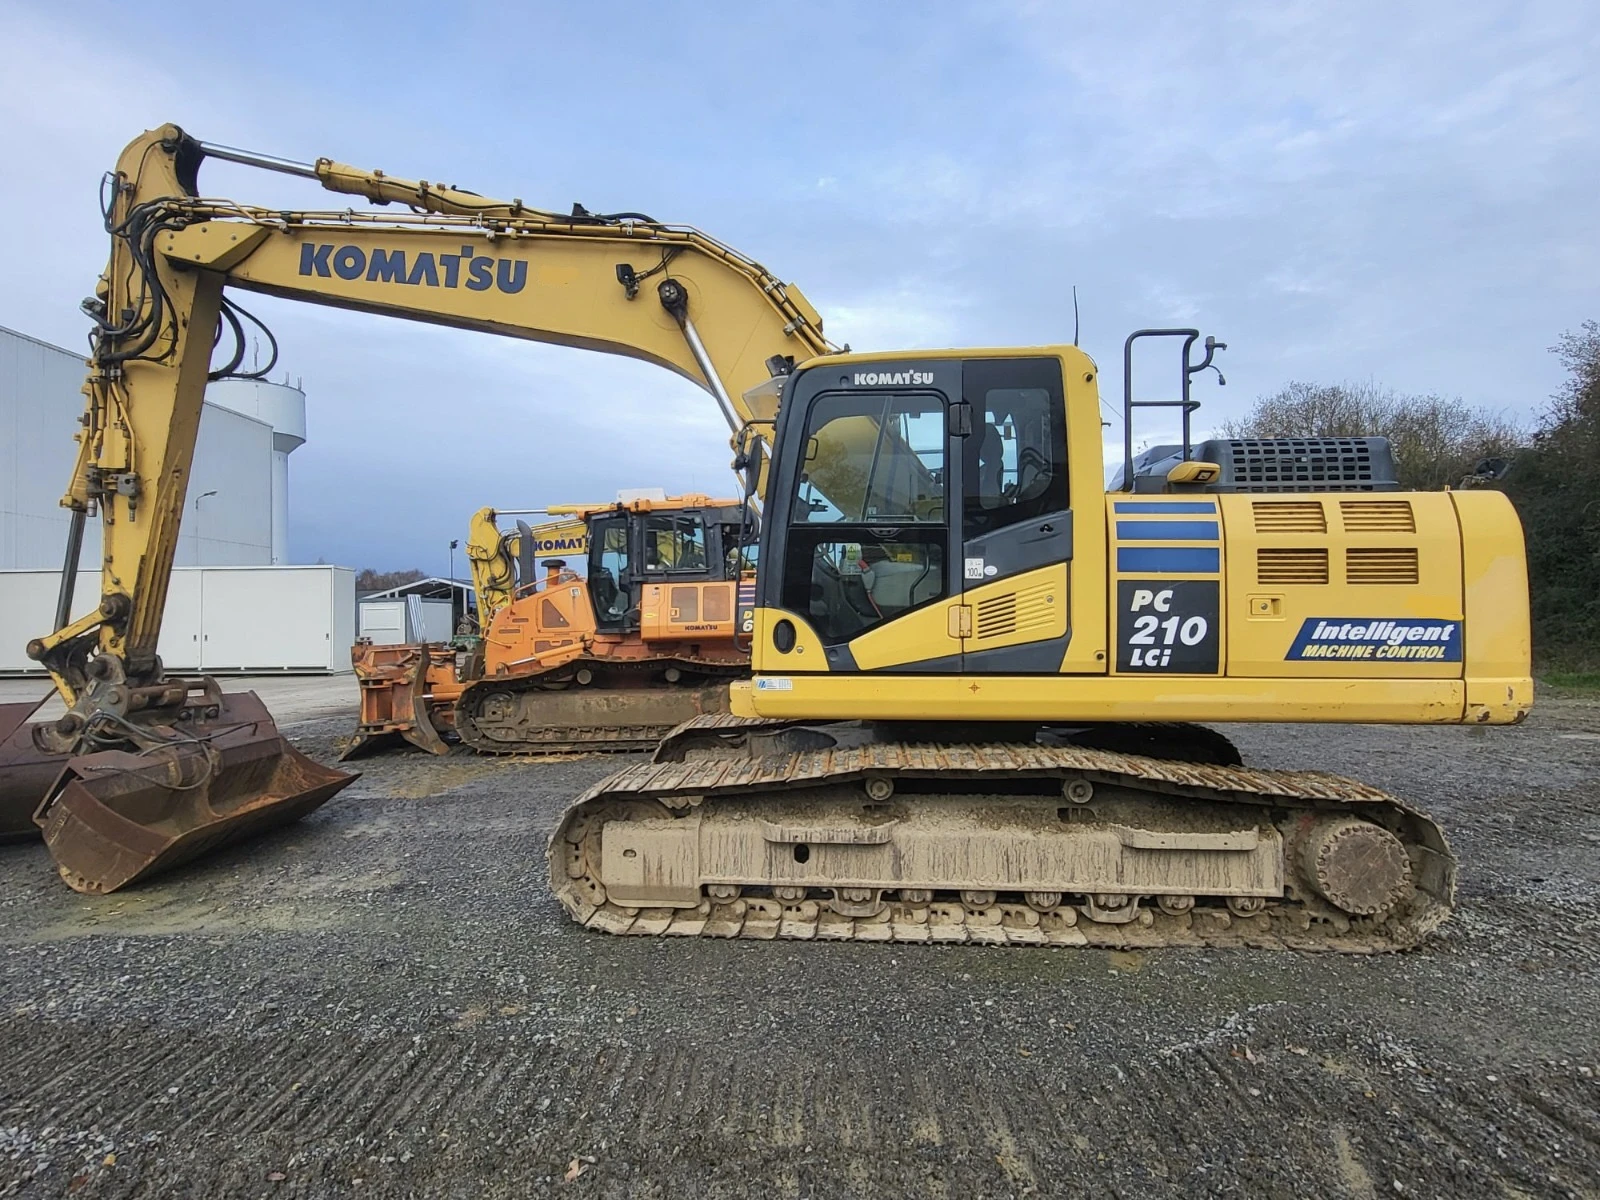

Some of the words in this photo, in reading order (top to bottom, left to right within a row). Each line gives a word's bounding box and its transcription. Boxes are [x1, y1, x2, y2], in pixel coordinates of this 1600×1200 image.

[299, 243, 528, 294] KOMATSU
[854, 369, 934, 386] KOMATSU
[1130, 589, 1174, 612] PC
[1128, 615, 1208, 646] 210
[1311, 621, 1455, 645] intelligent
[1129, 648, 1172, 667] LCi
[1301, 644, 1375, 658] MACHINE
[1375, 645, 1446, 659] CONTROL
